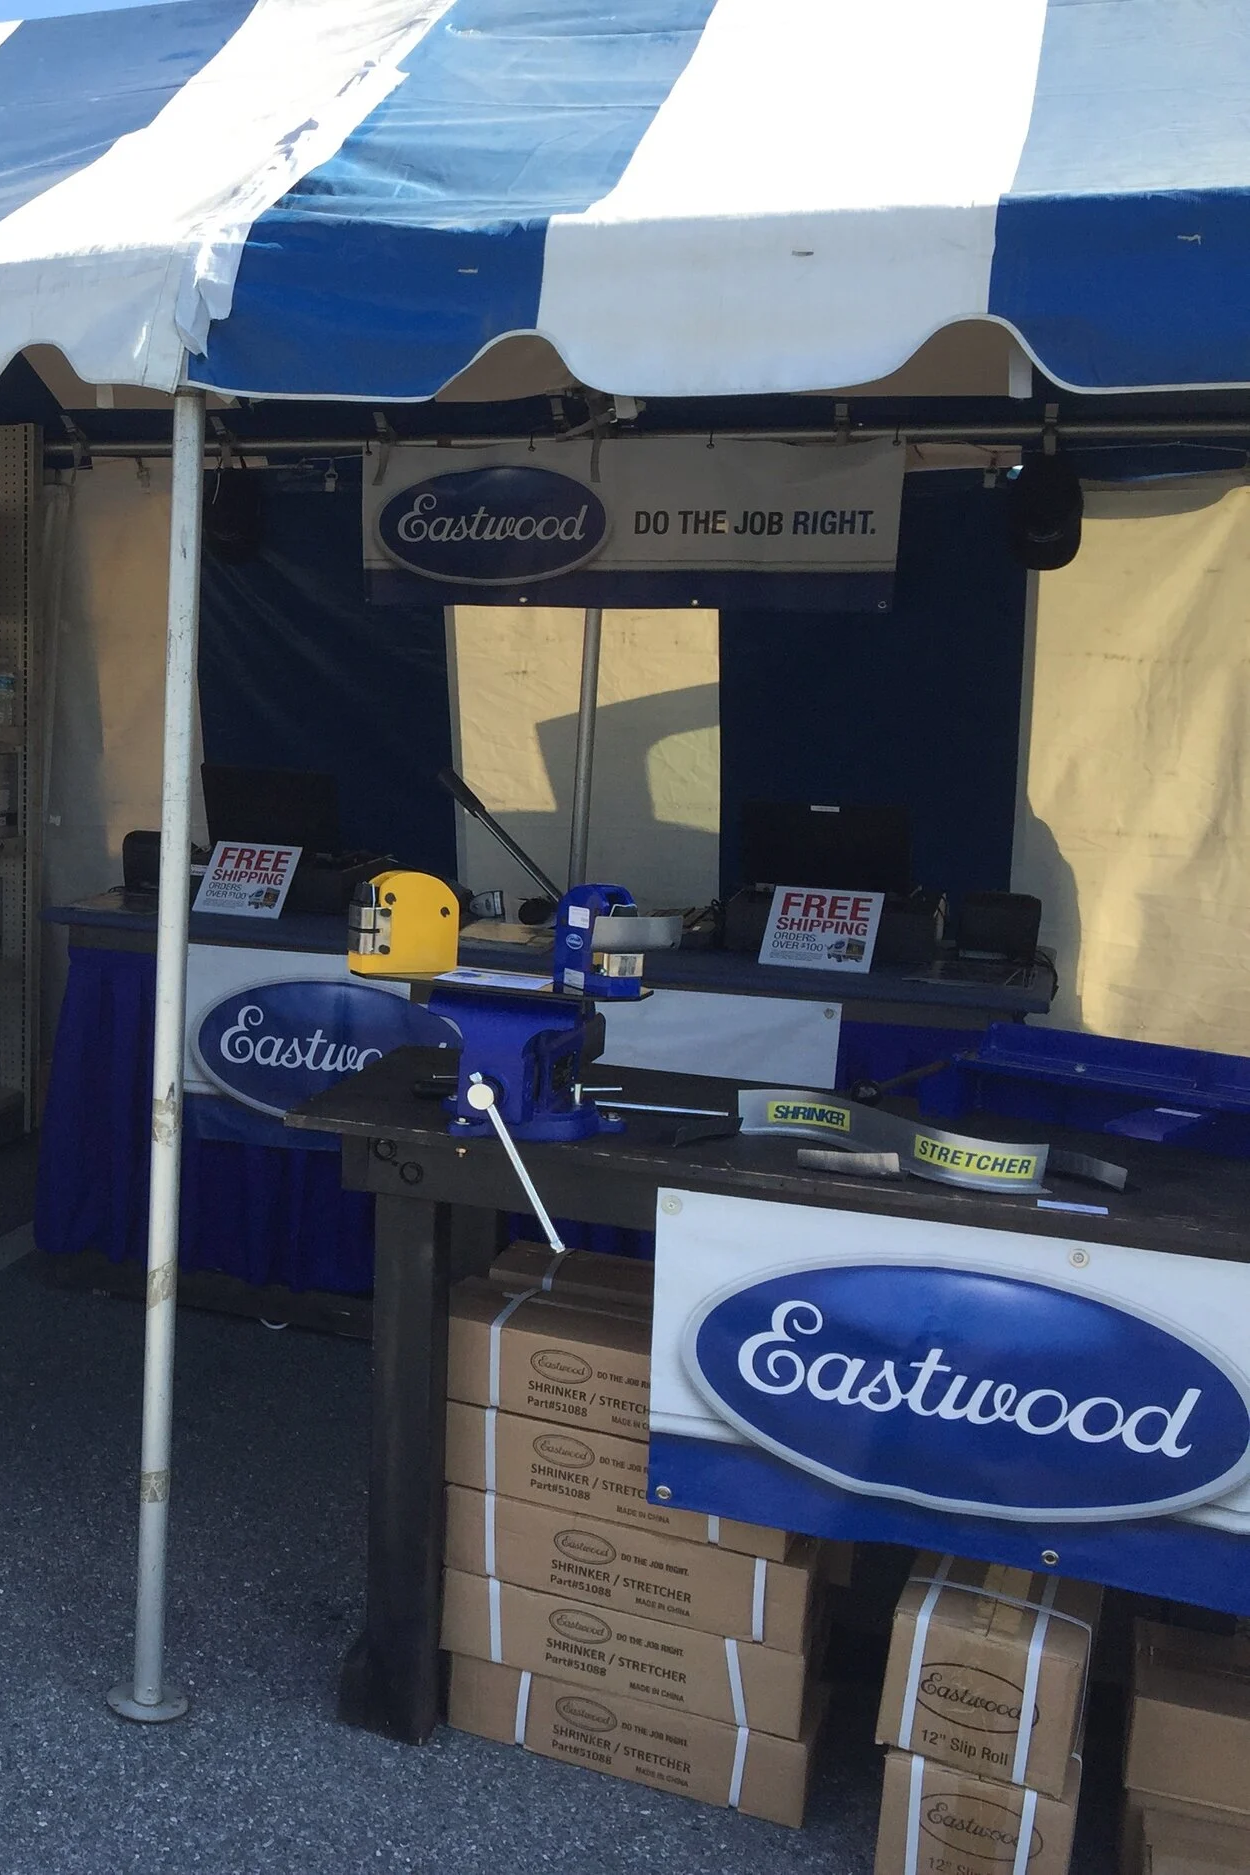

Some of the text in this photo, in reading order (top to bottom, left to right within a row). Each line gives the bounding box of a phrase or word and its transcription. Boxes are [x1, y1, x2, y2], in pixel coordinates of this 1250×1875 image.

[397, 493, 589, 542] Eastwood
[634, 509, 876, 536] DO THE JOB RIGHT.
[217, 847, 292, 873] FREE
[208, 881, 242, 891] ORDERS
[212, 868, 284, 886] SHIPPING
[206, 890, 227, 898] OVER
[780, 892, 873, 922] FREE
[773, 931, 817, 942] ORDERS
[776, 916, 868, 936] SHIPPING
[772, 940, 799, 950] OVER
[220, 1005, 383, 1072] Eastwo
[773, 1104, 846, 1127] SHRINKER
[918, 1140, 1032, 1174] STRETCHER
[538, 1355, 586, 1376] Eastwood
[597, 1371, 608, 1380] DO
[610, 1373, 623, 1384] THE
[625, 1377, 639, 1386] JOB
[738, 1300, 1202, 1458] Eastwood
[527, 1396, 588, 1417] Part#51088
[528, 1380, 650, 1415] SHRINKER / STRETCH
[612, 1416, 631, 1427] MADE
[540, 1440, 588, 1460] Eastwood
[599, 1456, 610, 1465] DO
[612, 1459, 625, 1470] THE
[627, 1463, 642, 1472] JOB
[530, 1478, 590, 1500] Part#51088
[531, 1463, 646, 1499] SHRINKER / STRETC
[616, 1505, 670, 1524] MADE IN CHINA
[561, 1535, 609, 1557] Eastwood
[621, 1553, 632, 1562] DO
[633, 1556, 647, 1566] THE
[649, 1560, 664, 1570] JOB
[550, 1574, 612, 1597] Part#51088
[551, 1559, 692, 1603] SHRINKER / STRETCHER
[635, 1597, 690, 1617] MADE IN CHINA
[557, 1615, 605, 1636] Eastwood
[616, 1633, 627, 1642] DO
[629, 1636, 643, 1646] THE
[644, 1641, 659, 1650] JOB
[545, 1652, 607, 1677] Part#51088
[546, 1638, 687, 1684] SHRINKER / STRETCHER
[629, 1682, 650, 1693] MADE
[661, 1690, 684, 1702] CHINA
[552, 1724, 691, 1774] SHRINKER / STRETCHER
[552, 1739, 612, 1765] Part#51088
[921, 1729, 1008, 1766] 12" Slip Roll
[927, 1802, 1018, 1847] Eastwoo
[929, 1856, 952, 1872] 12"
